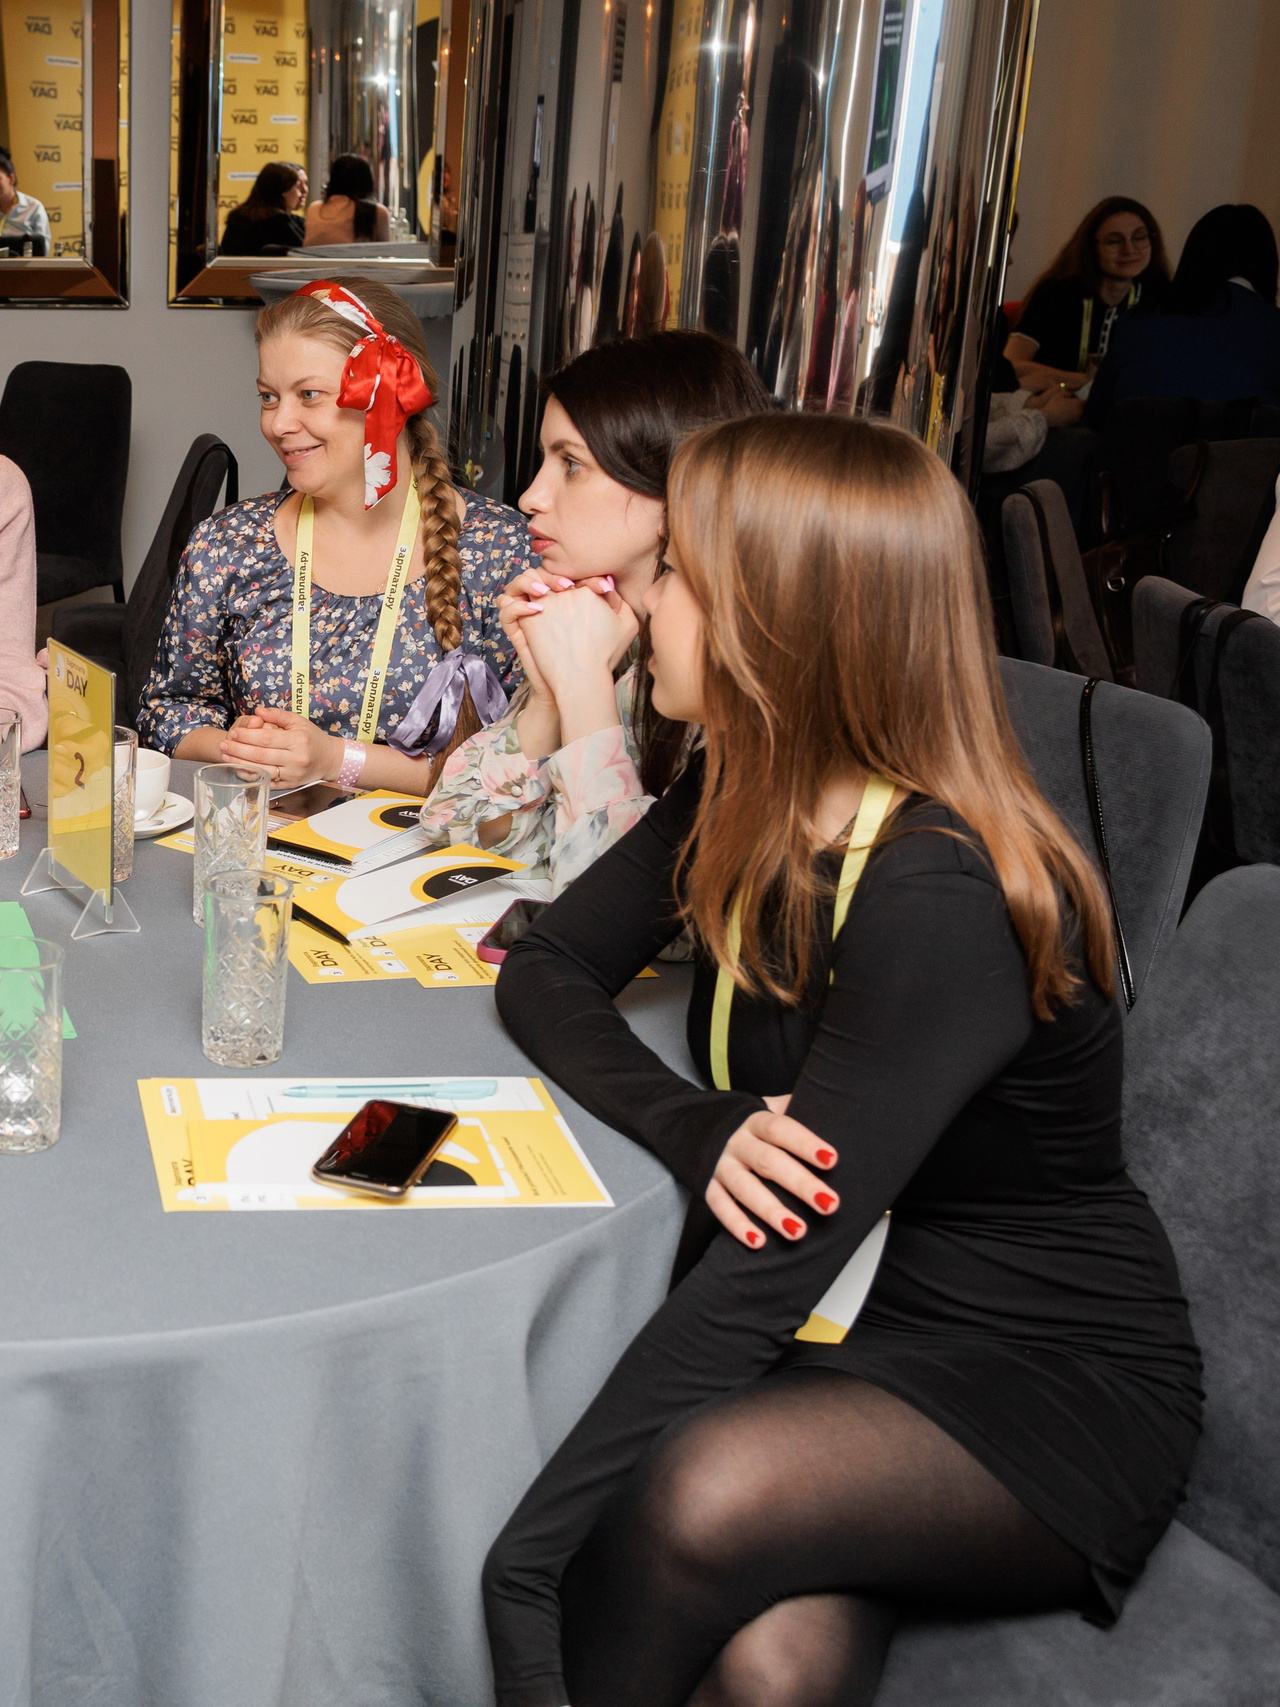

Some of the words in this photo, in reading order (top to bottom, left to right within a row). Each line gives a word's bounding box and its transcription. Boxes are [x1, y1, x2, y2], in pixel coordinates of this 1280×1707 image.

[67, 669, 88, 697] DAY
[74, 752, 85, 790] 2
[273, 865, 315, 877] DAY
[449, 874, 478, 884] DAY
[310, 950, 338, 966] DAY
[423, 954, 452, 971] DAY
